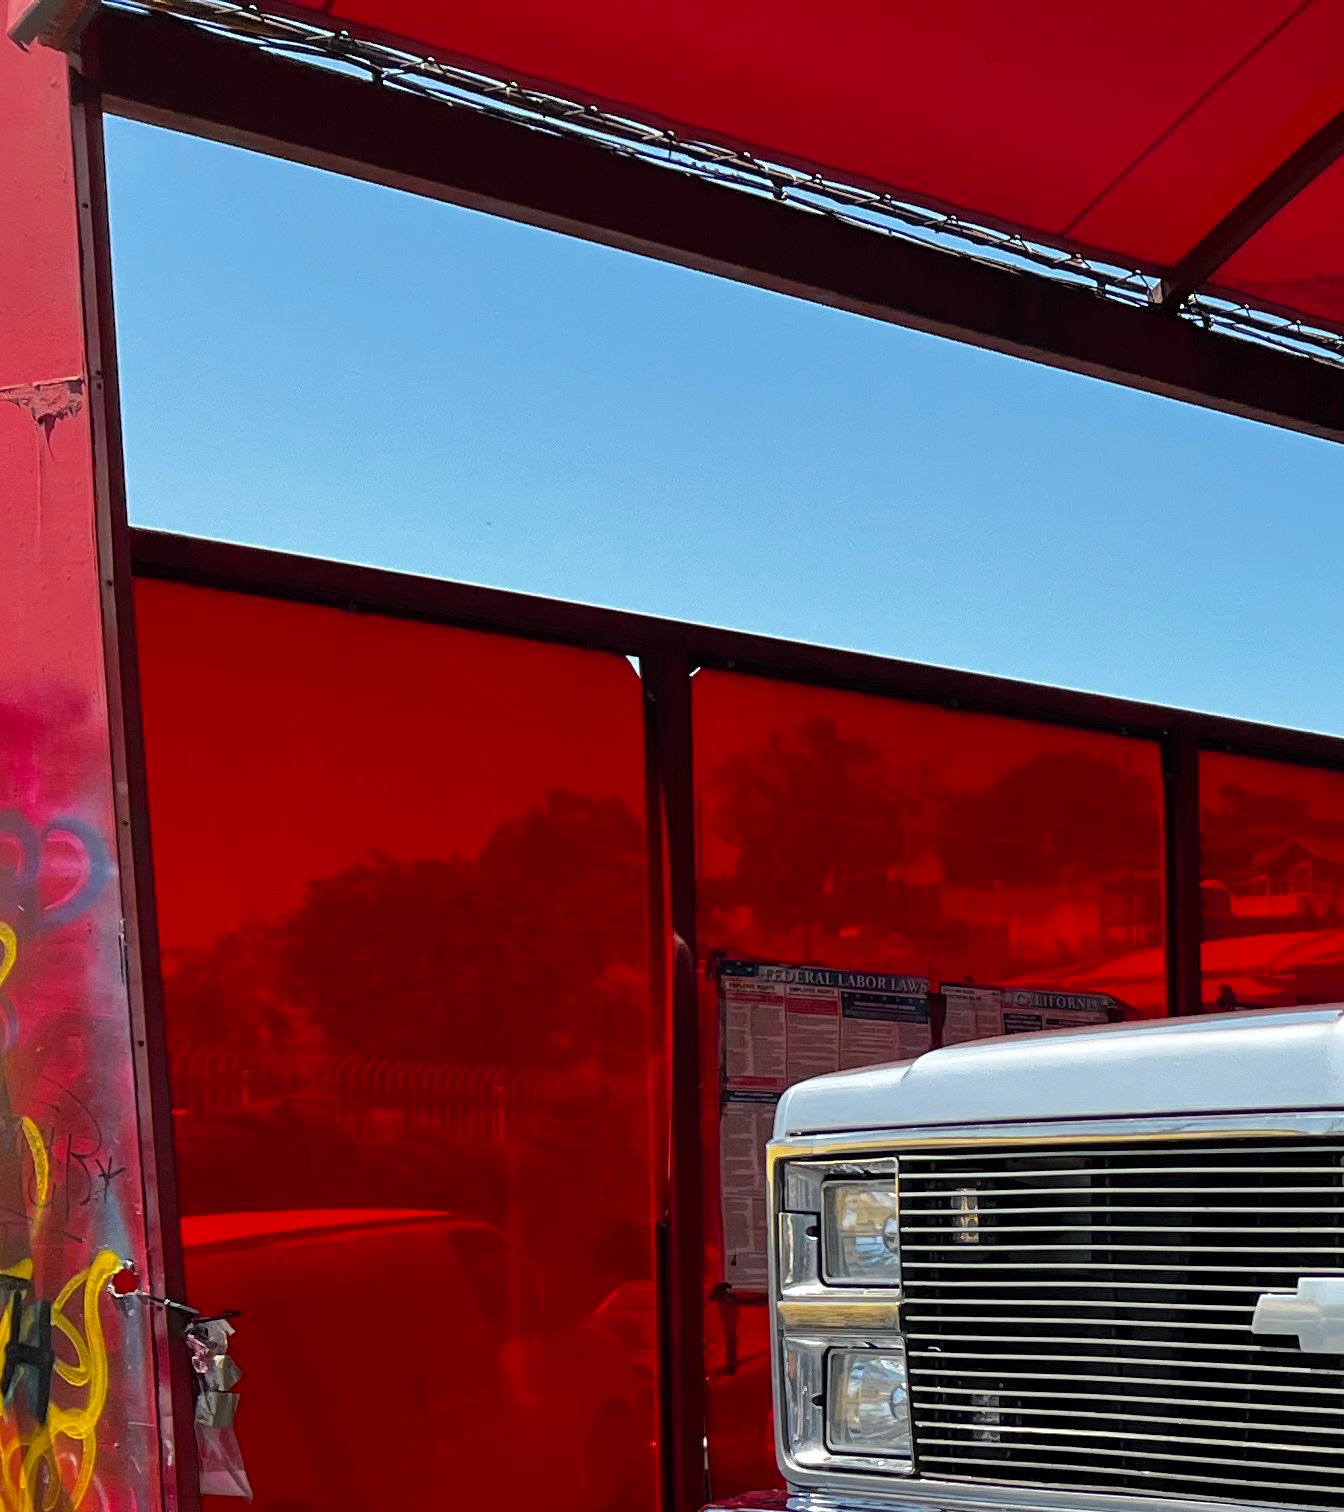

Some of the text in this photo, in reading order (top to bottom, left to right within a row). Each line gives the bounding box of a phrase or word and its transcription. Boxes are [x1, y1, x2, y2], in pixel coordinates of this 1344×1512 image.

[765, 968, 928, 994] FEDERAL LABOR LAWS
[1015, 993, 1104, 1011] CALIFORNIA
